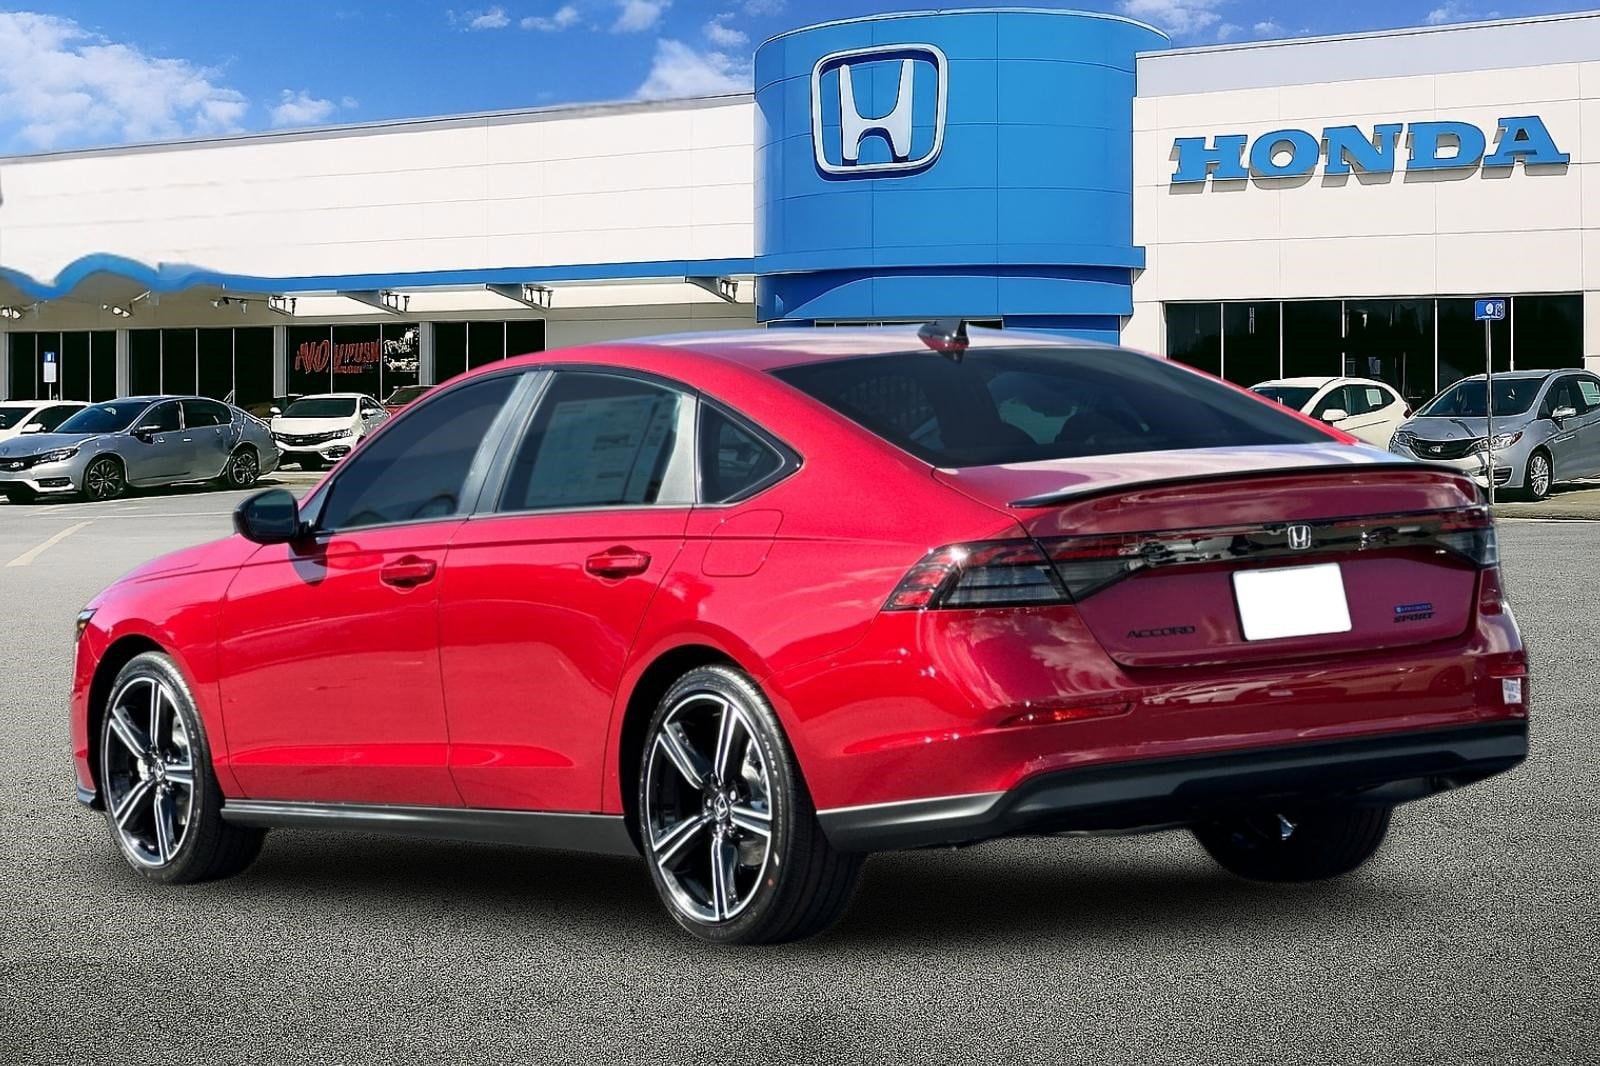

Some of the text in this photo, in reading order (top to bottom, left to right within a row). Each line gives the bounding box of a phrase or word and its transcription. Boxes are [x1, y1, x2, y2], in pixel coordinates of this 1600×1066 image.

[1171, 115, 1570, 185] HONDA
[1393, 611, 1436, 623] SPORT
[1126, 625, 1196, 639] ACCORD
